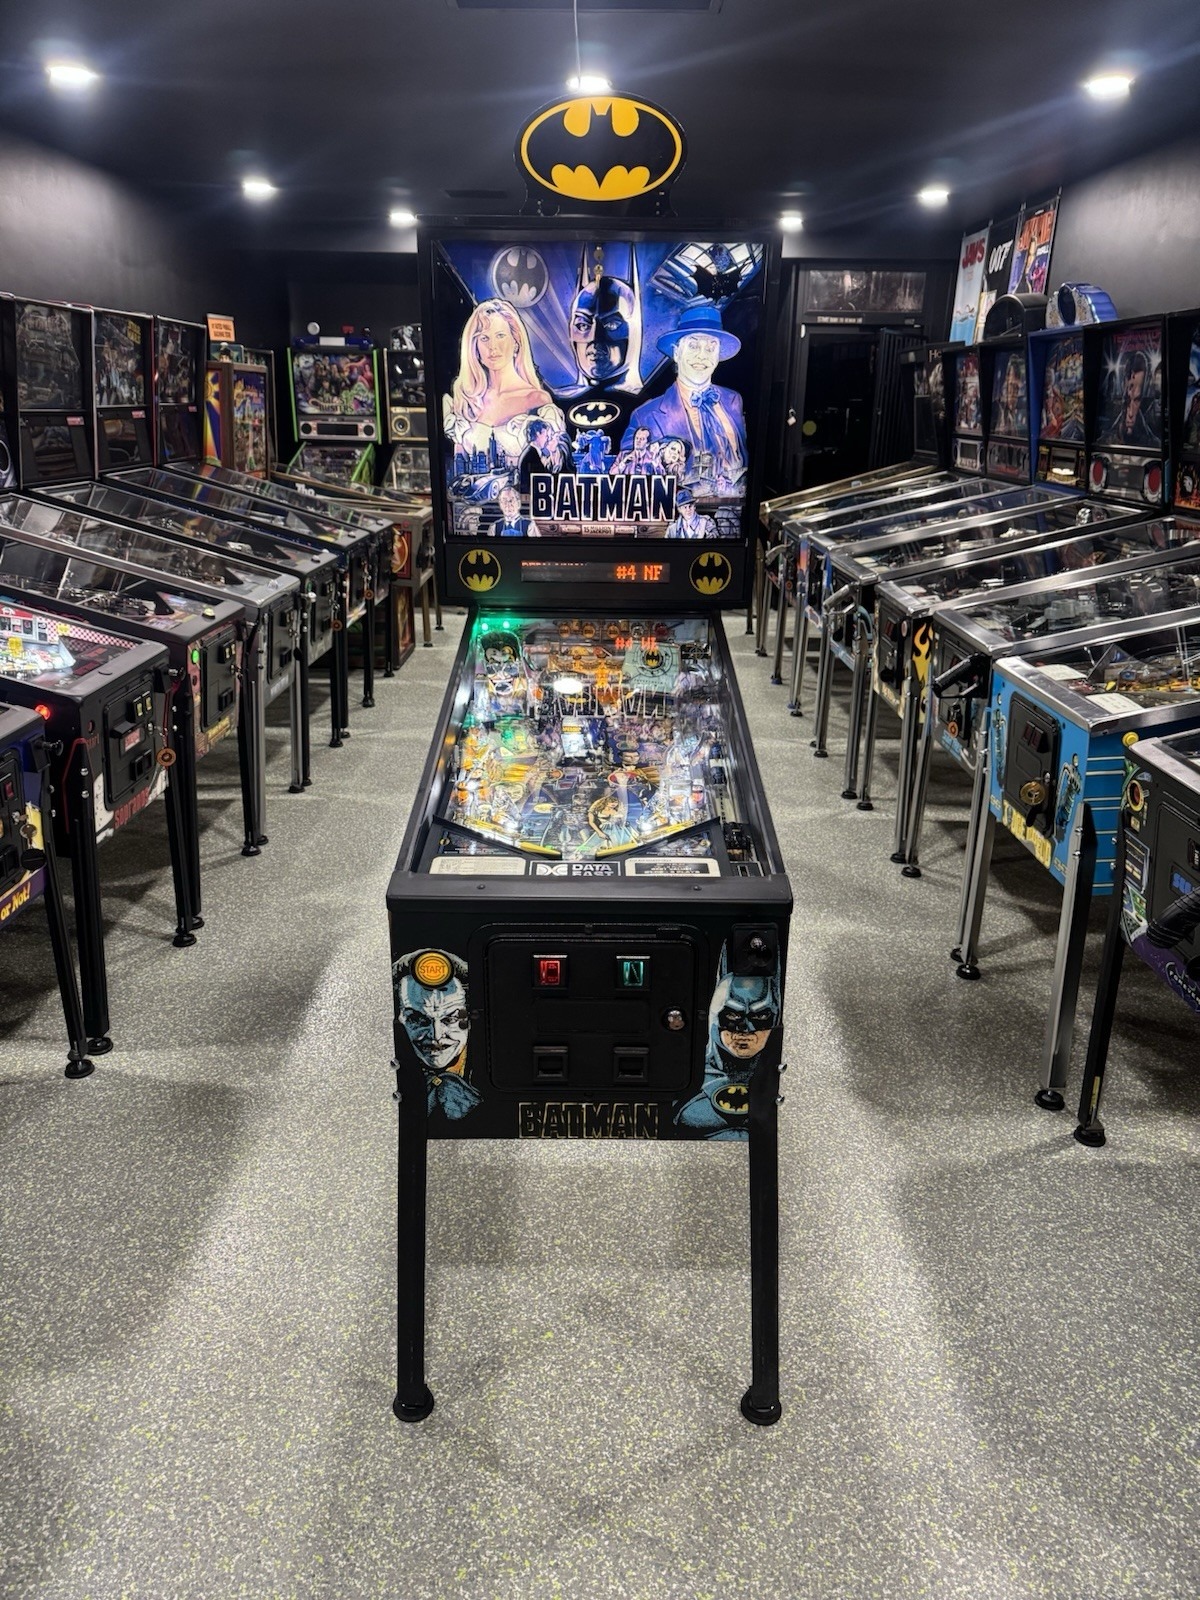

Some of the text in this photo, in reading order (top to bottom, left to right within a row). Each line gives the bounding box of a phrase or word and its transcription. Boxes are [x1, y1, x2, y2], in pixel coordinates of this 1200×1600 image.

[962, 237, 986, 270] JAWS
[988, 240, 1014, 275] 007
[530, 473, 677, 522] BATMAN
[616, 564, 663, 581] #4 NF
[571, 863, 613, 871] DATA
[419, 965, 446, 974] START
[518, 1102, 659, 1139] BATMAN
